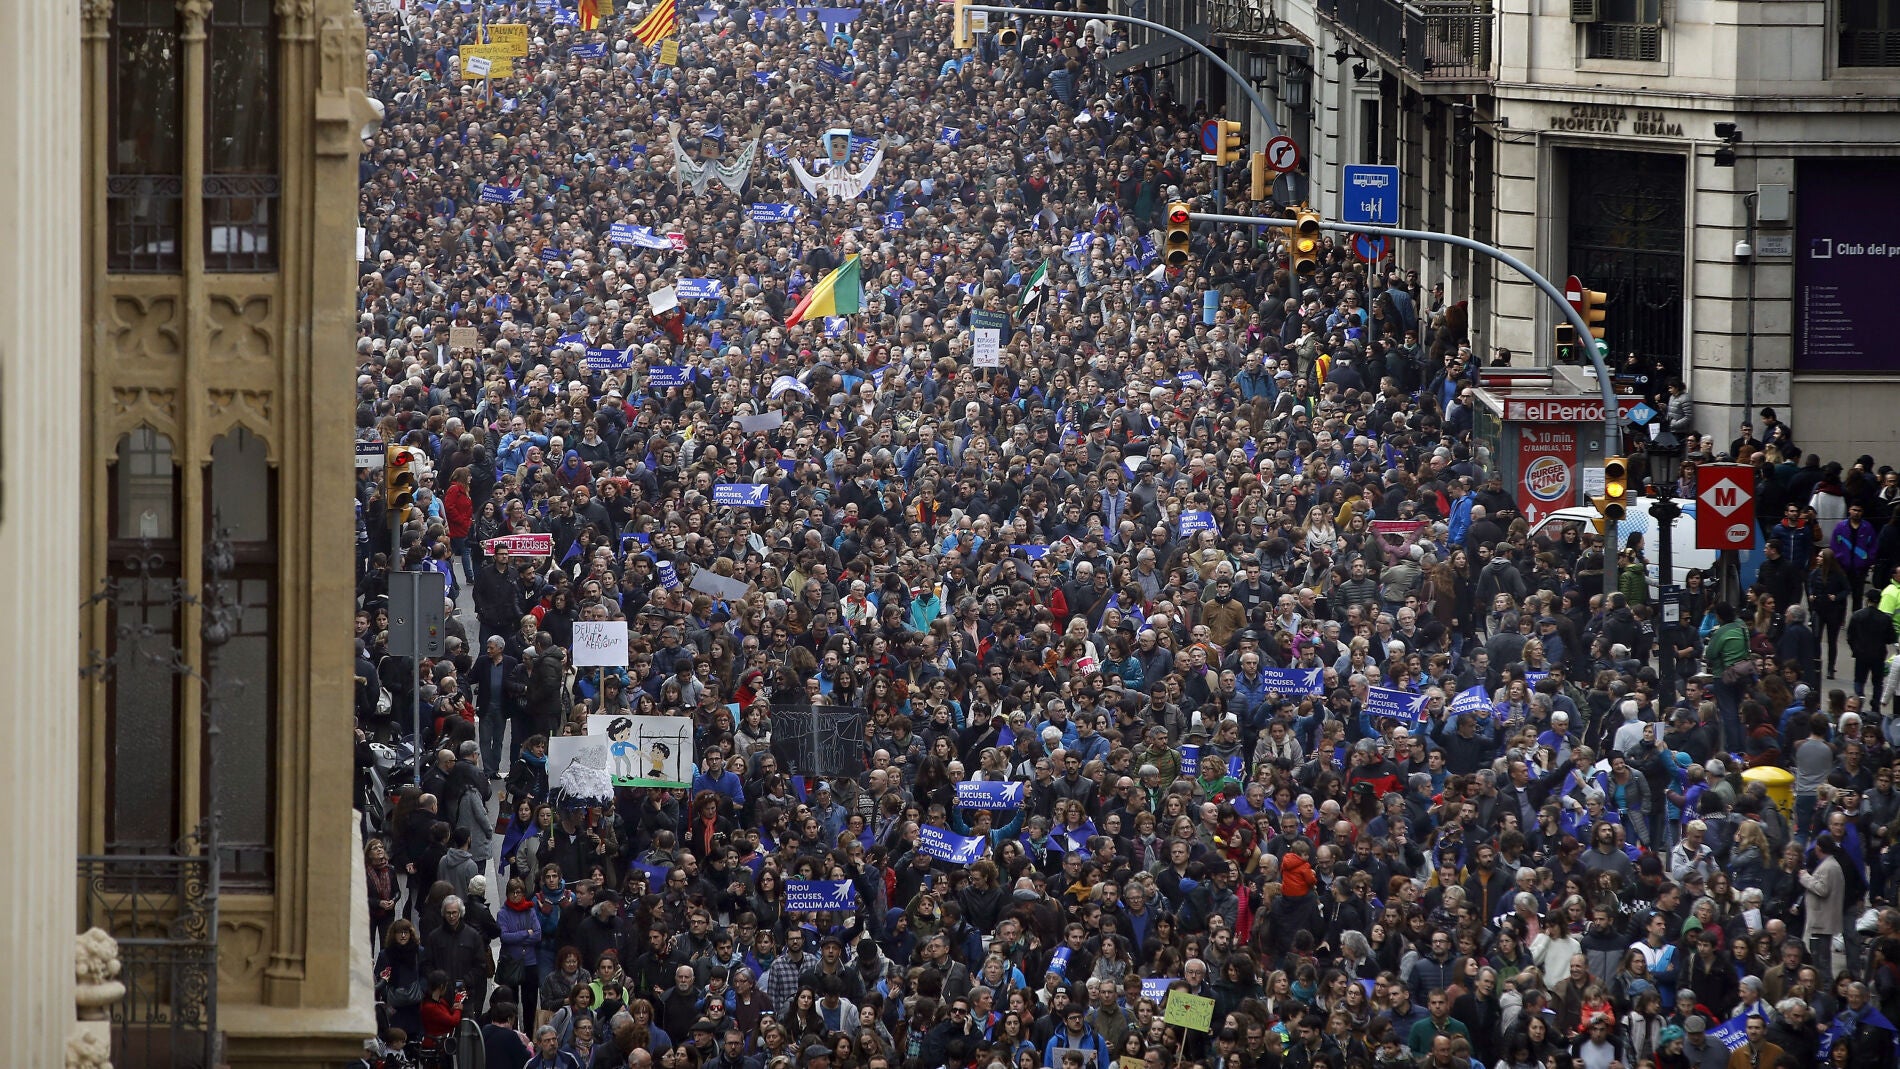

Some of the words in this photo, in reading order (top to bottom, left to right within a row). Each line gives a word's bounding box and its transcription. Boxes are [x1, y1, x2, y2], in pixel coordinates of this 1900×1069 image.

[1571, 106, 1627, 120] CAMBRA
[1638, 111, 1648, 121] DE
[1652, 111, 1665, 122] LA
[1551, 117, 1619, 132] PROPIETAT
[1634, 121, 1684, 136] URBANA
[1837, 244, 1863, 255] Club
[1867, 243, 1885, 255] del
[1527, 402, 1544, 419] el
[1540, 433, 1551, 443] 10
[1553, 432, 1574, 443] min.
[1531, 464, 1564, 480] BURGER
[1532, 472, 1566, 491] KING
[1715, 487, 1737, 506] M
[516, 541, 549, 550] EXCUSES
[1369, 691, 1388, 699] PROU
[1369, 699, 1399, 709] EXCUSES,
[1456, 702, 1480, 712] COLLIM
[1367, 707, 1396, 716] ACOLLIM
[959, 792, 992, 800] EXCUSES,
[923, 828, 943, 839] PROU
[920, 838, 953, 852] EXCUSES,
[919, 846, 951, 860] ACOLLIM
